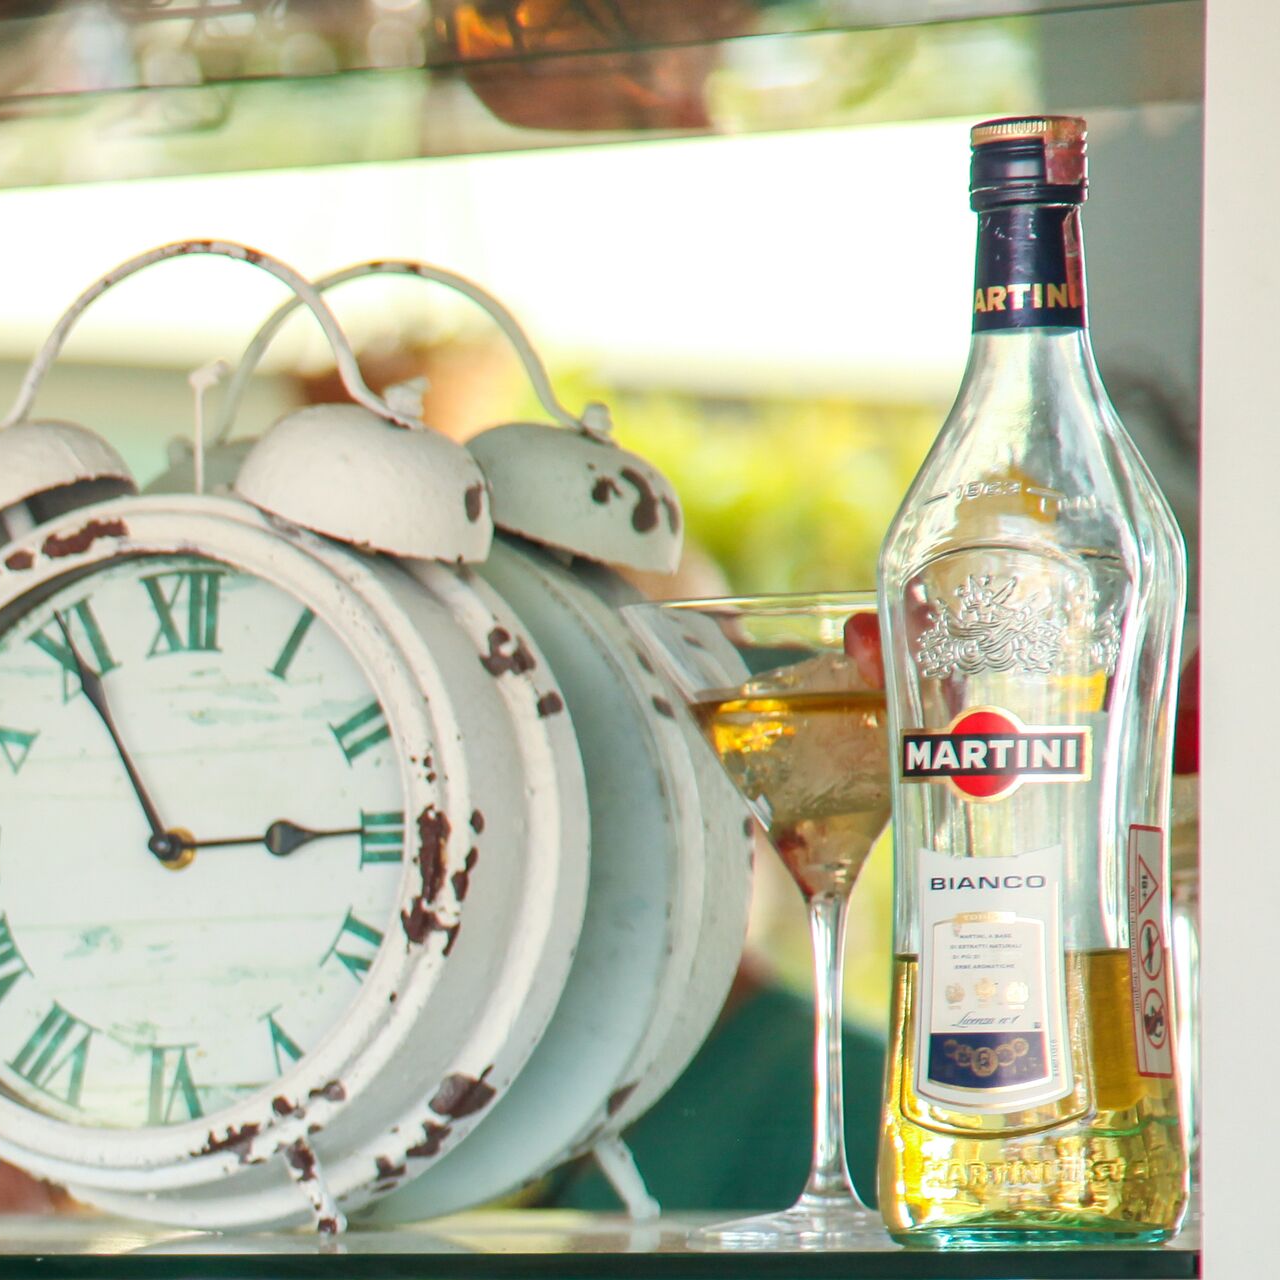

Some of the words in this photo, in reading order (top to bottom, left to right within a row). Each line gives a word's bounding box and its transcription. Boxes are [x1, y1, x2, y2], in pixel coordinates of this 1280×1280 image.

[974, 283, 1069, 313] ARTIN
[140, 569, 227, 659] XII
[328, 700, 393, 767] II
[906, 738, 1078, 770] MARTINI
[930, 874, 1047, 891] BIANCO
[7, 999, 103, 1112] VII
